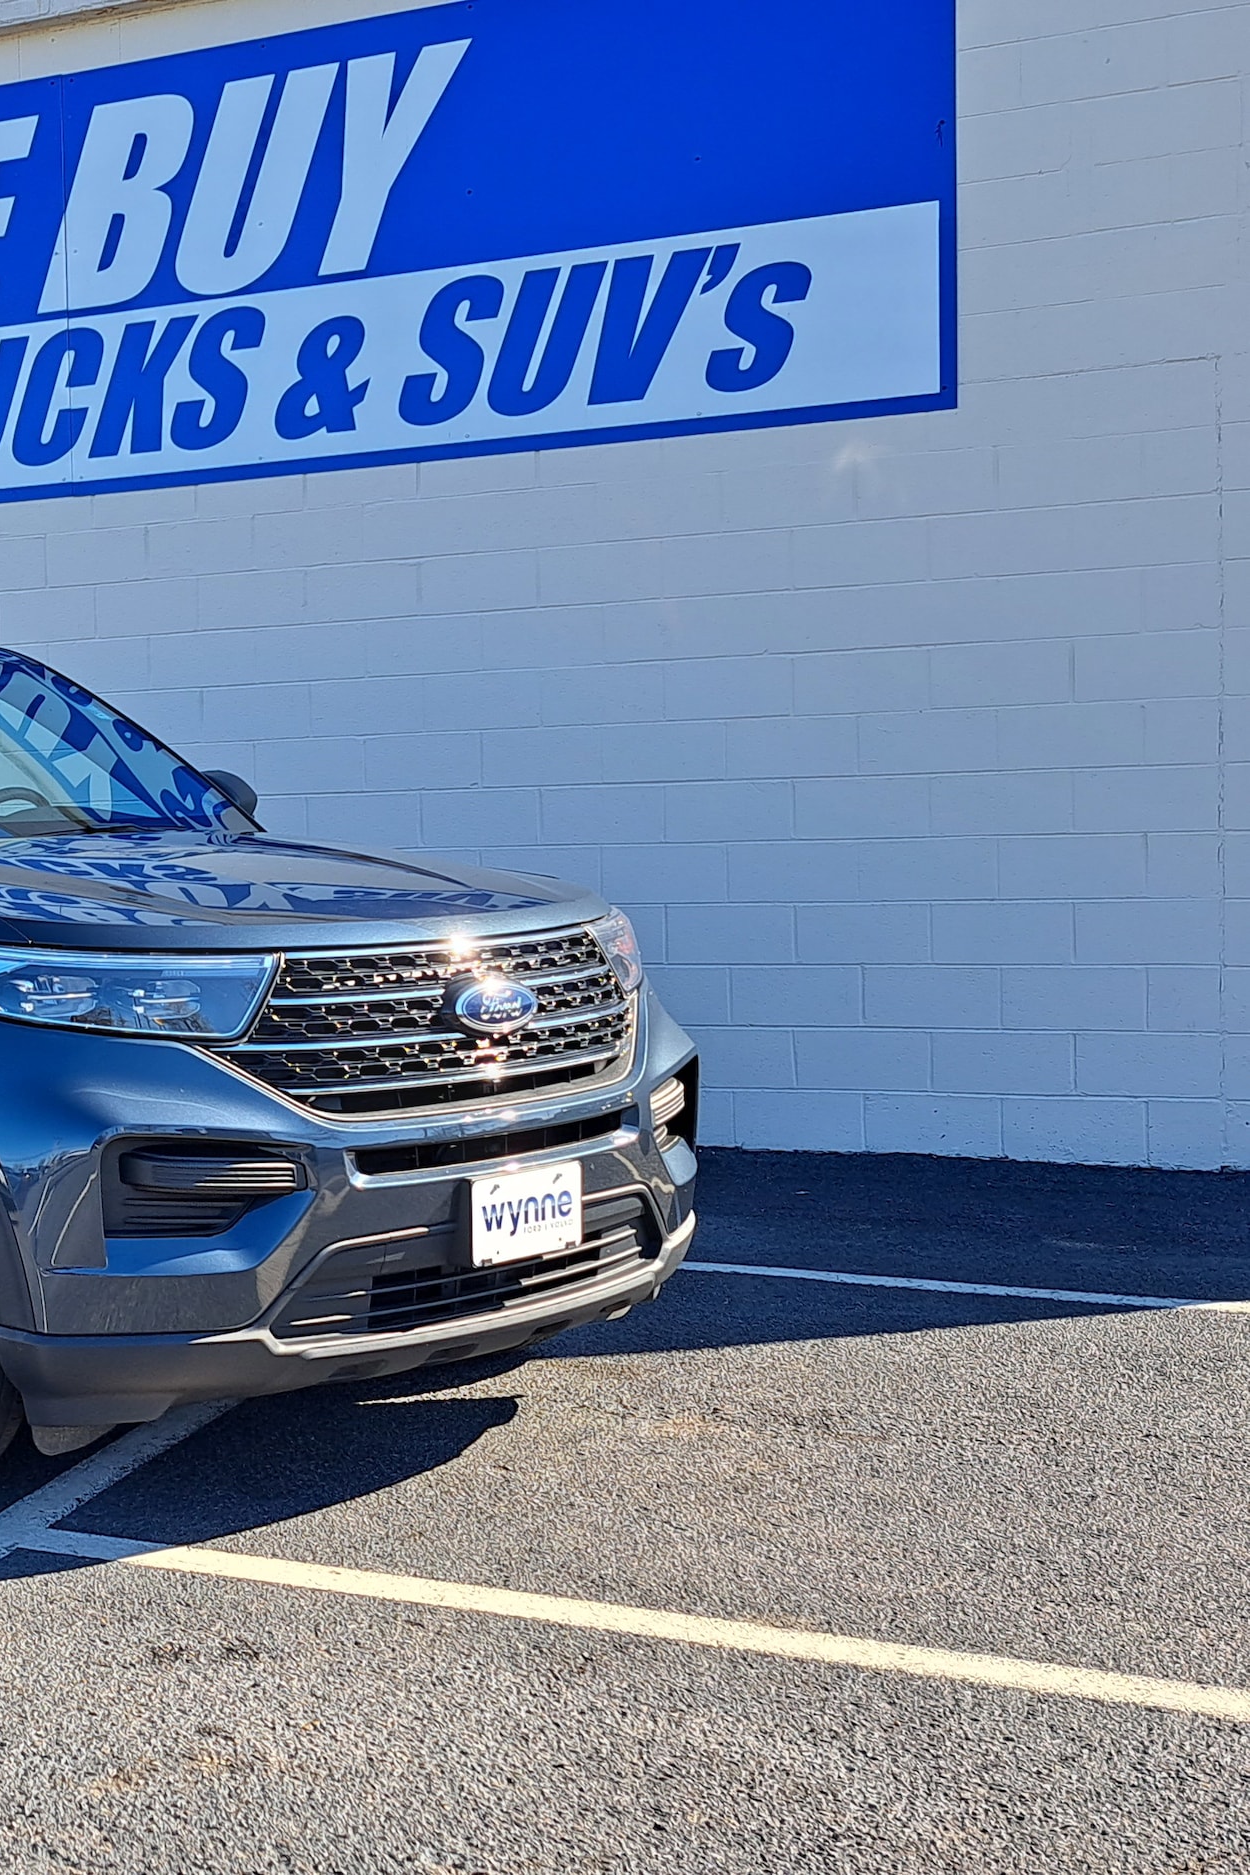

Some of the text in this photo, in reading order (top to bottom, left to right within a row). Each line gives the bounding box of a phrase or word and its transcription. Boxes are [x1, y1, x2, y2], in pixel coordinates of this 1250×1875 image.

[37, 37, 473, 314] BUY
[274, 315, 371, 441] &
[482, 1190, 572, 1237] wynne
